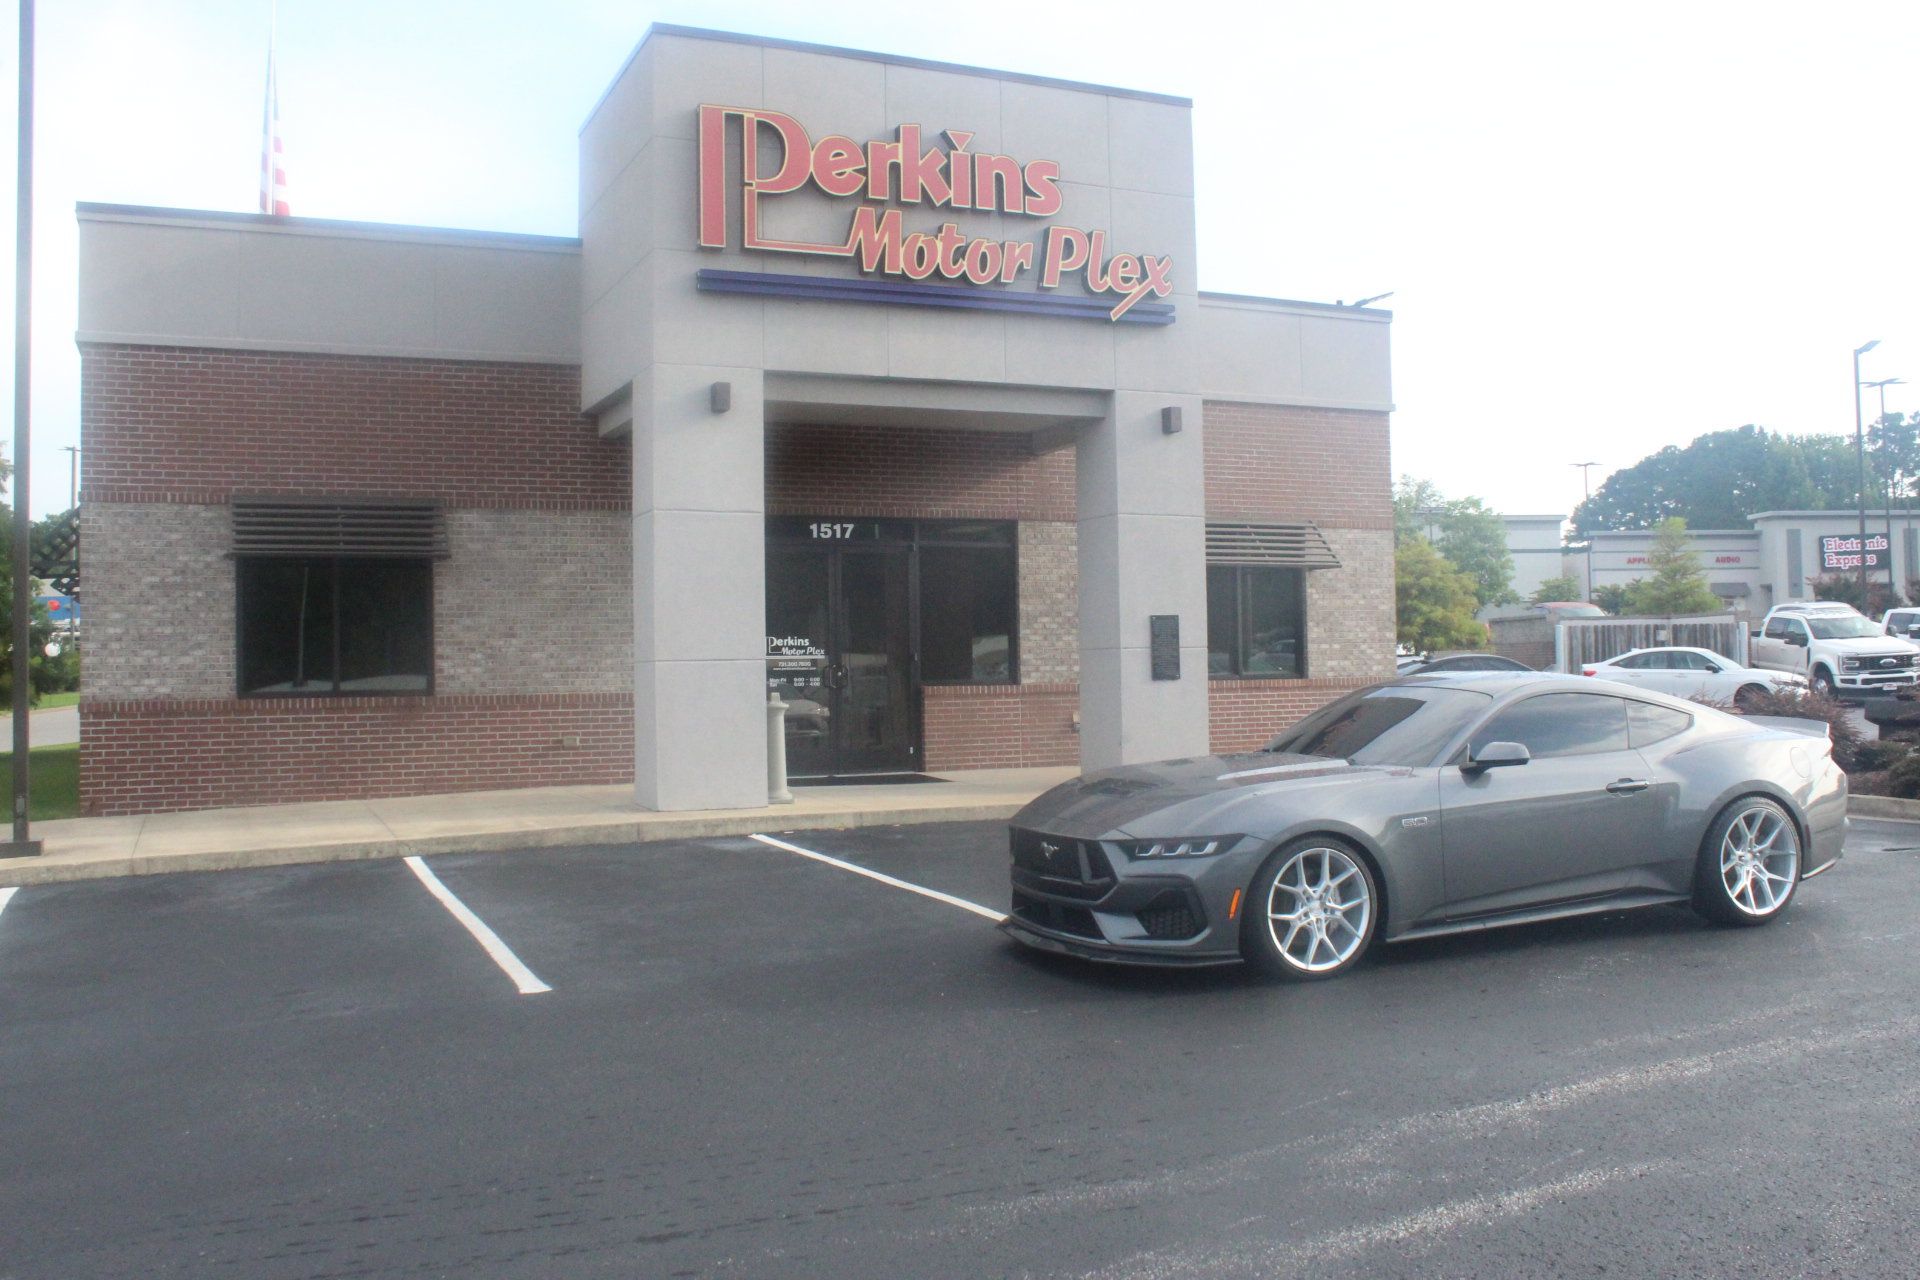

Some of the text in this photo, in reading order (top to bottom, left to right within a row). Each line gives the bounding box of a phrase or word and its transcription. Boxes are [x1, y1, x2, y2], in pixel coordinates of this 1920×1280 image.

[698, 103, 1063, 250] Perkins
[845, 206, 1174, 321] Motor Plex
[809, 523, 855, 539] 1517
[1823, 536, 1888, 552] Electrnic
[1715, 556, 1741, 564] AUDIO
[1824, 553, 1877, 569] Expres
[766, 636, 810, 654] Perkins
[781, 646, 825, 656] Motor Plex
